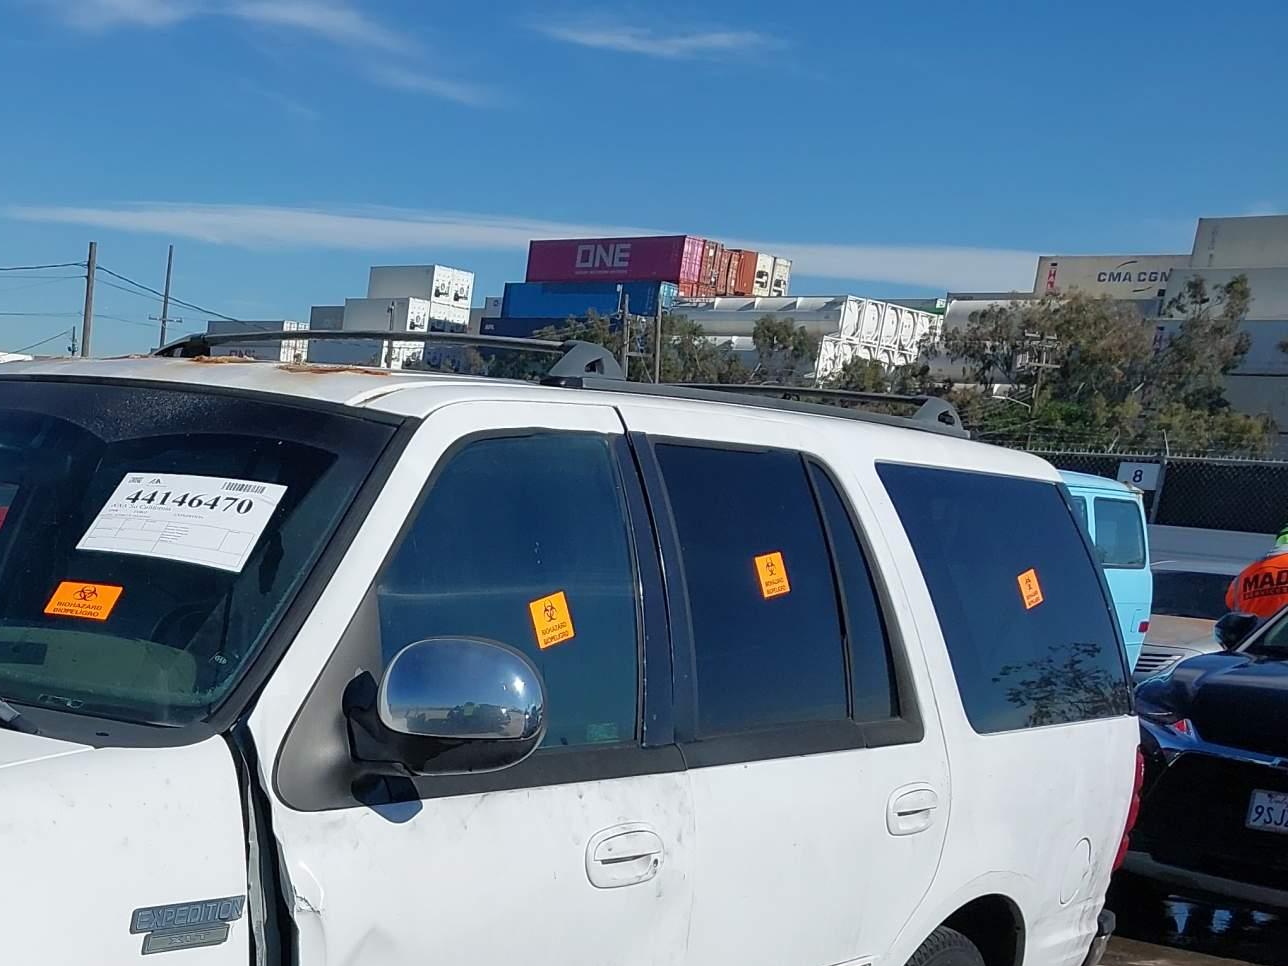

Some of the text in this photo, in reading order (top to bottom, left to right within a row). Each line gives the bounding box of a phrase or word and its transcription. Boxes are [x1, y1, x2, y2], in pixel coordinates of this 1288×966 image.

[575, 243, 632, 268] ONE
[1097, 271, 1132, 283] CMA
[1133, 469, 1143, 483] 8
[126, 489, 253, 515] 44146470
[56, 601, 103, 611] BIOHAZARD
[136, 899, 244, 930] EXPEDITION
[168, 932, 206, 946] XLT
